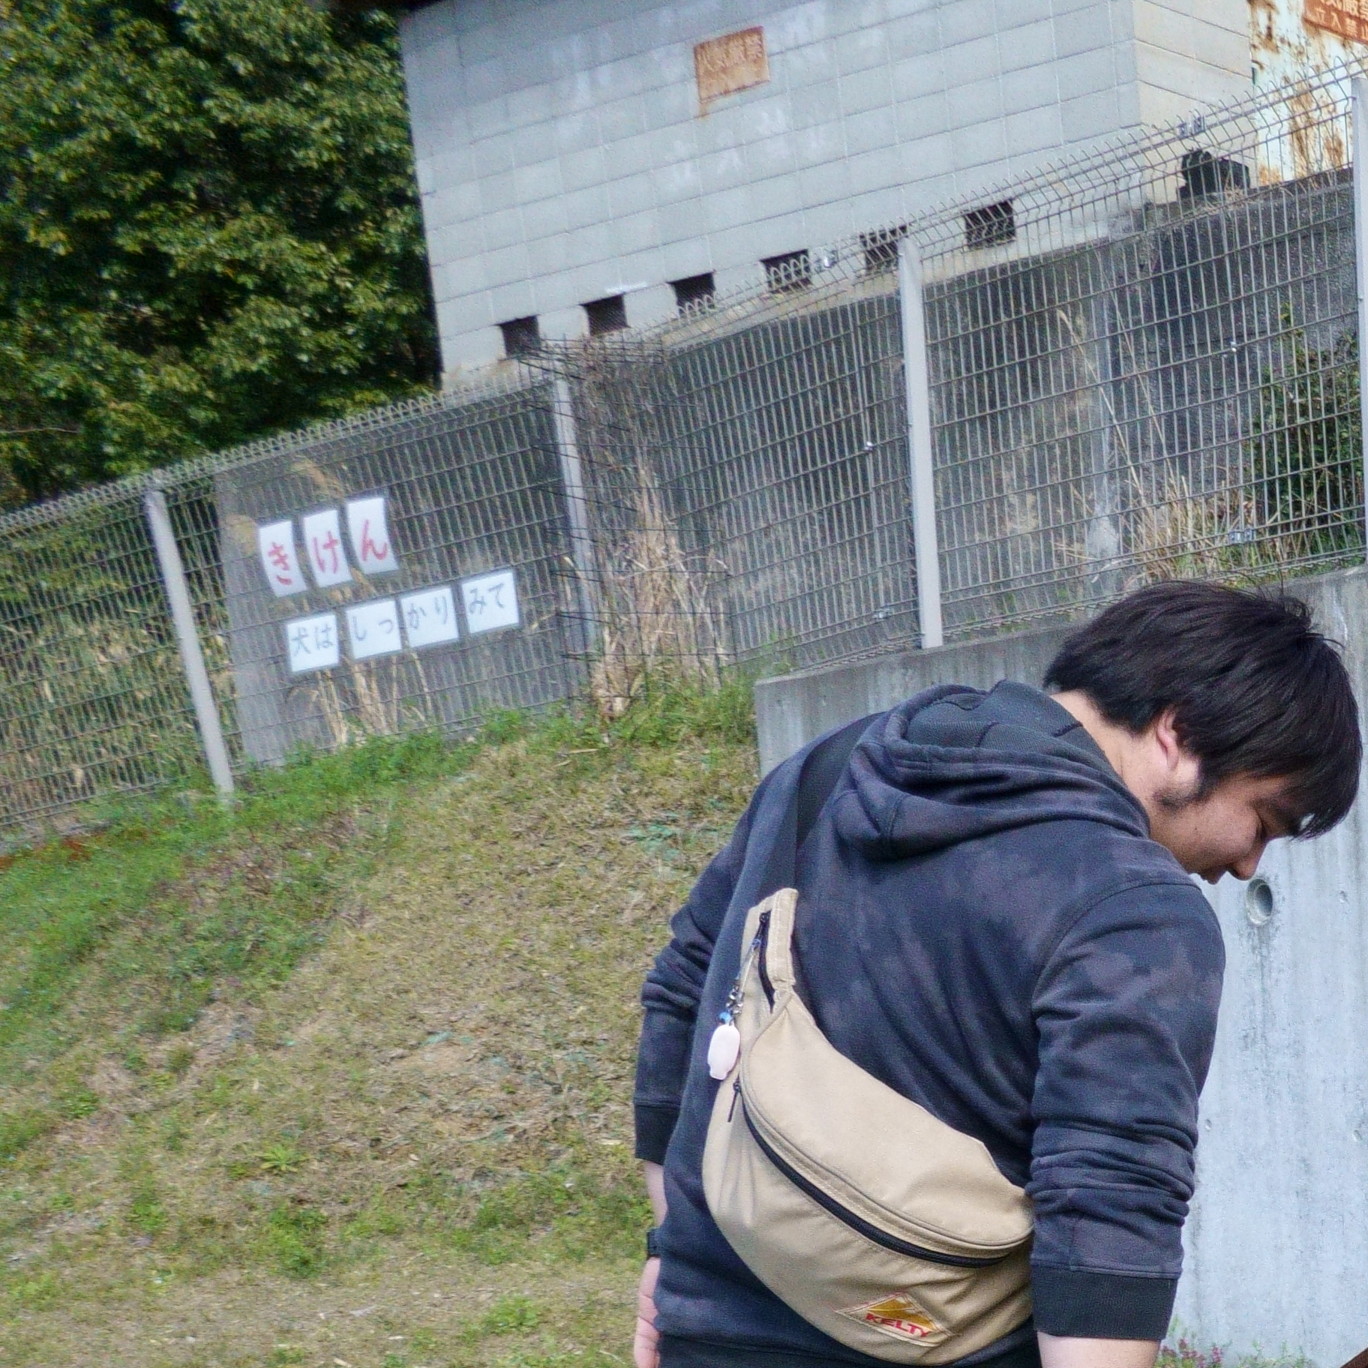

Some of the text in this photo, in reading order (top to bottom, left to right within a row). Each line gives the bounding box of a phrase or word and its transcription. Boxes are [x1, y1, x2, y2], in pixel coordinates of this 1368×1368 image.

[268, 519, 388, 586] きけん
[865, 1313, 931, 1337] KELTY
